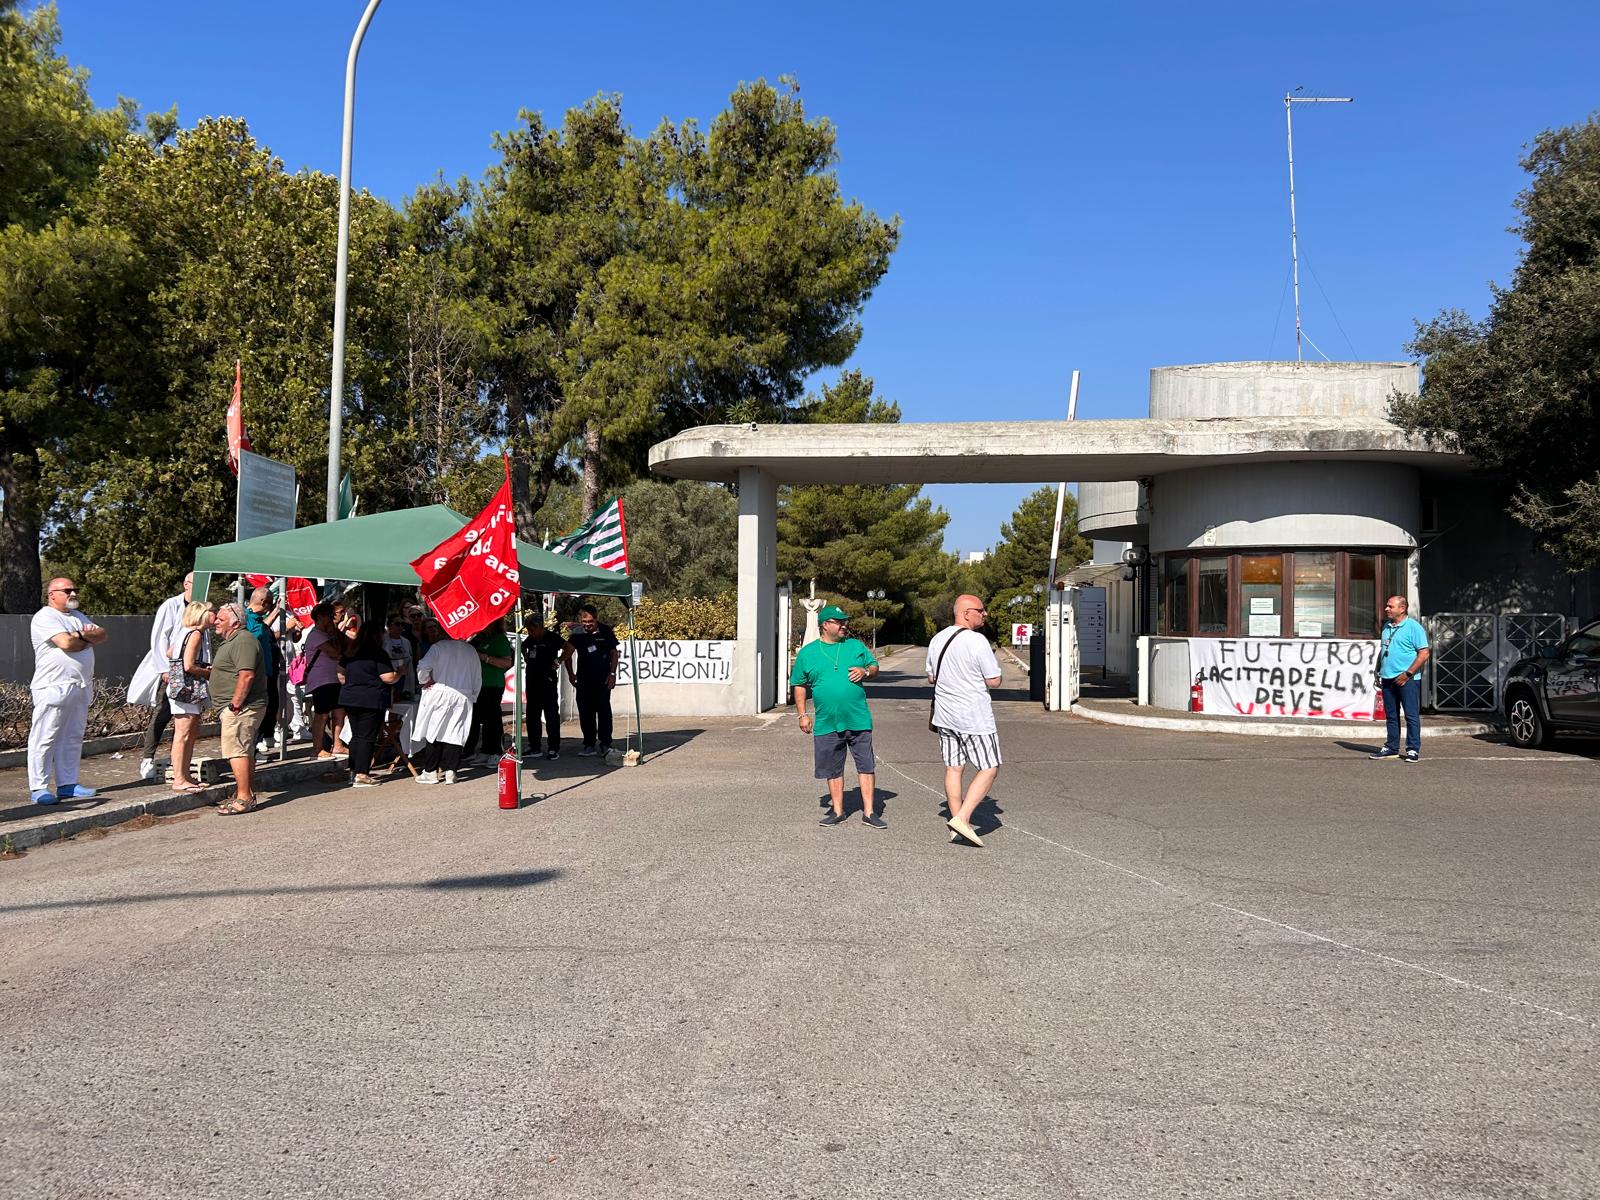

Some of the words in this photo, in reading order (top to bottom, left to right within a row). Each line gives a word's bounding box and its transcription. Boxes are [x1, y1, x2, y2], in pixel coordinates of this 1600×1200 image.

[694, 641, 722, 660] LE
[1218, 640, 1377, 674] FUTURO?
[1255, 687, 1324, 711] DEVE
